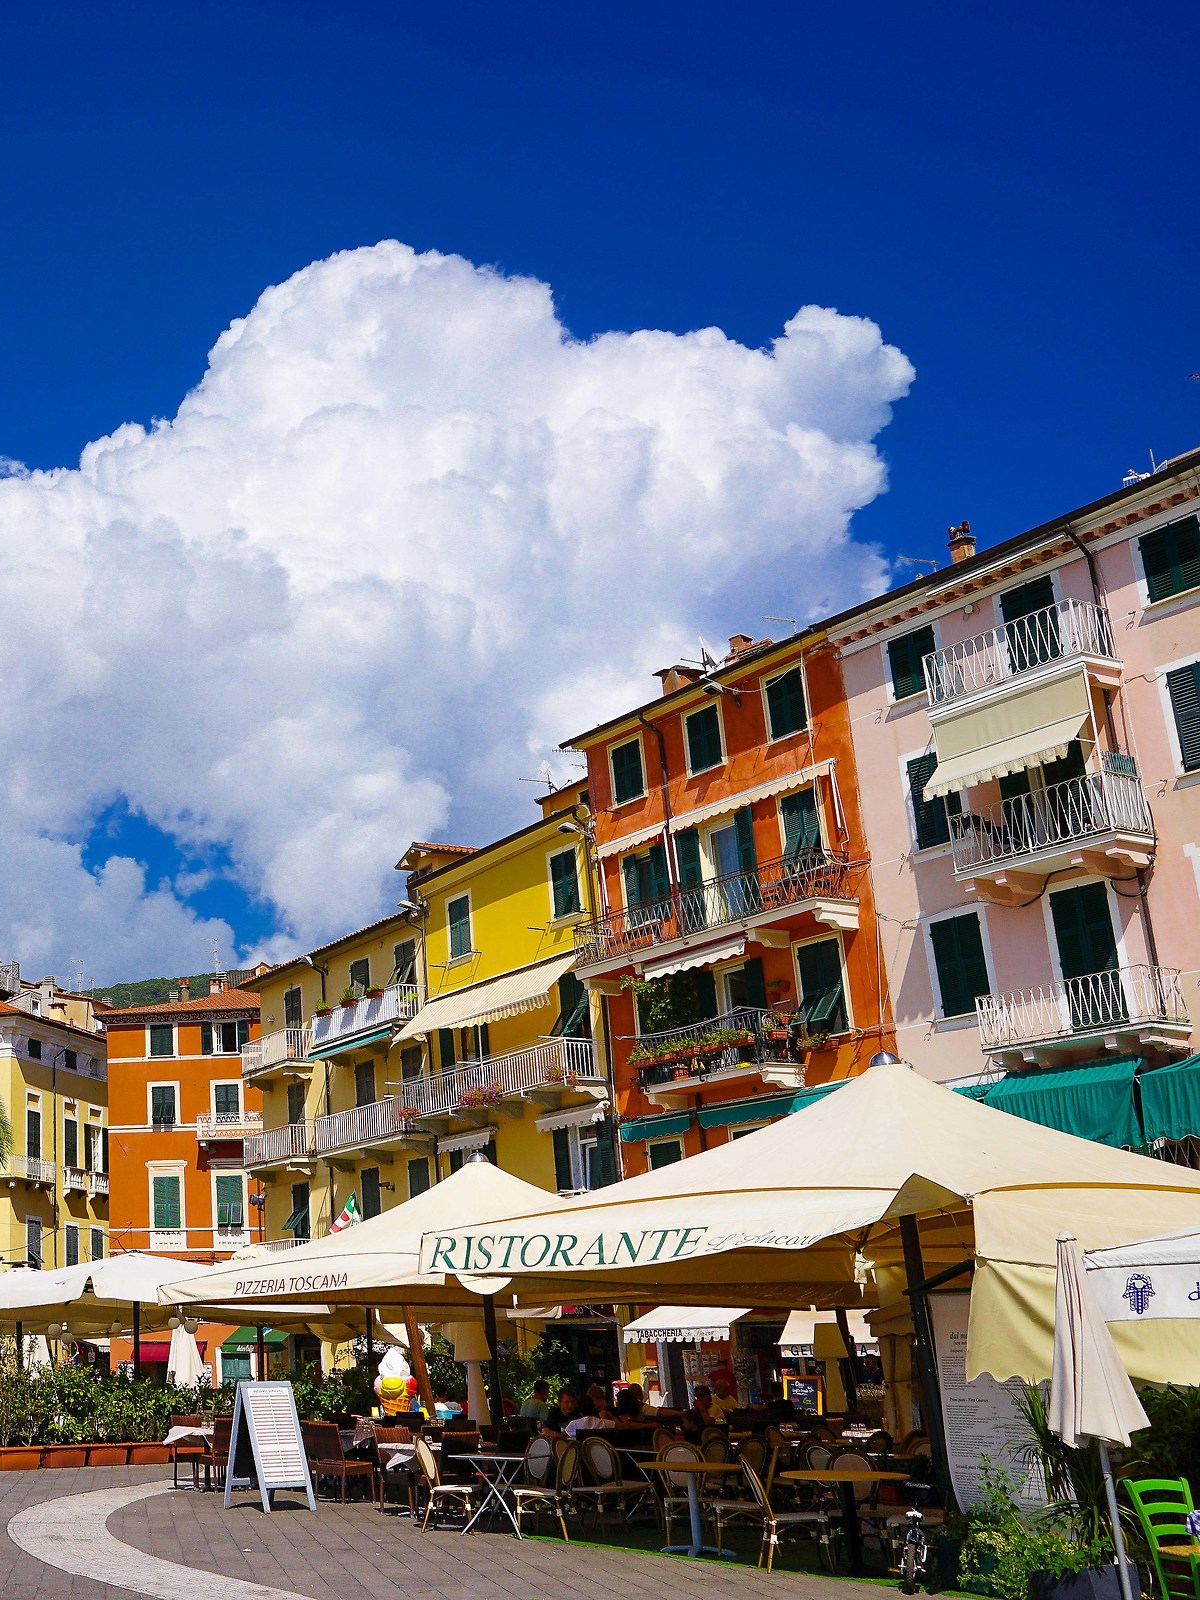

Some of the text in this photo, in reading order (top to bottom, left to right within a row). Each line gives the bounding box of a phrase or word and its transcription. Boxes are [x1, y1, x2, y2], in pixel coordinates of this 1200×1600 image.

[429, 1226, 708, 1270] RISTORANTE
[234, 1273, 348, 1295] PIZZERIA TOSCANA
[636, 1328, 683, 1338] TABACCHERIA
